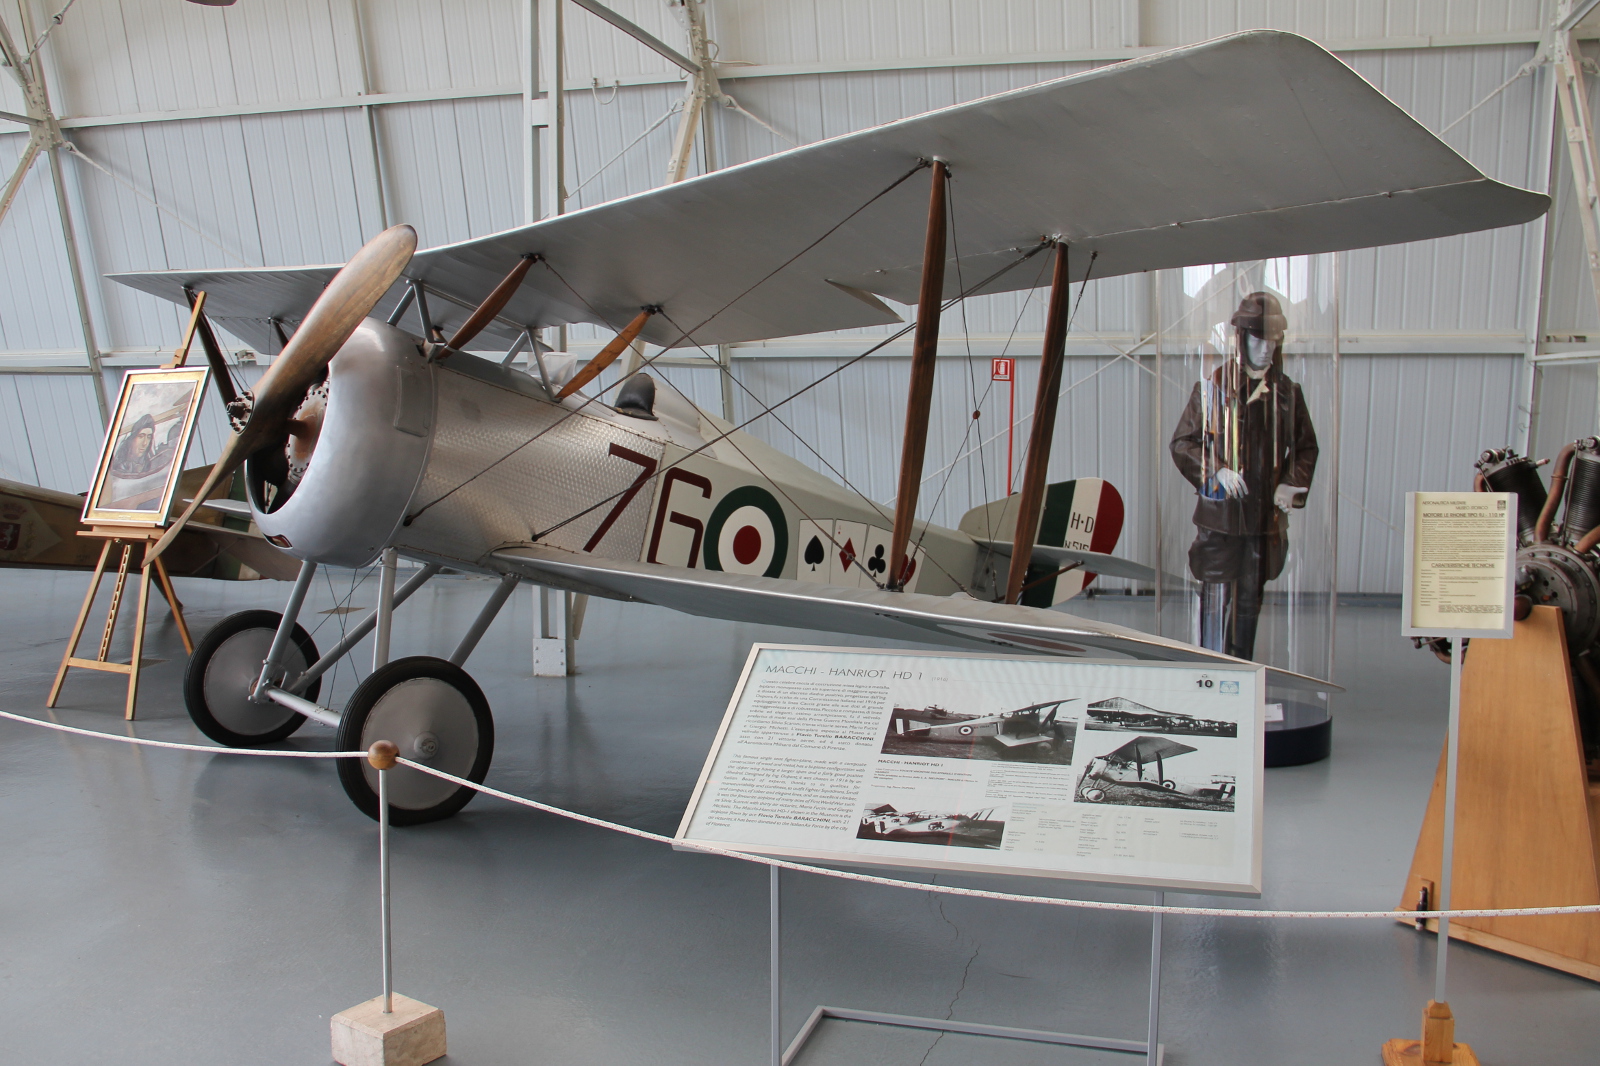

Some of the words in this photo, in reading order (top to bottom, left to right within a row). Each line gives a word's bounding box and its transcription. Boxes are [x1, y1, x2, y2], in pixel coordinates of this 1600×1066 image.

[765, 665, 817, 675] MACCHI
[828, 667, 886, 679] HANRIOT
[892, 671, 912, 680] HD
[917, 672, 923, 680] 1
[1196, 679, 1213, 688] 10
